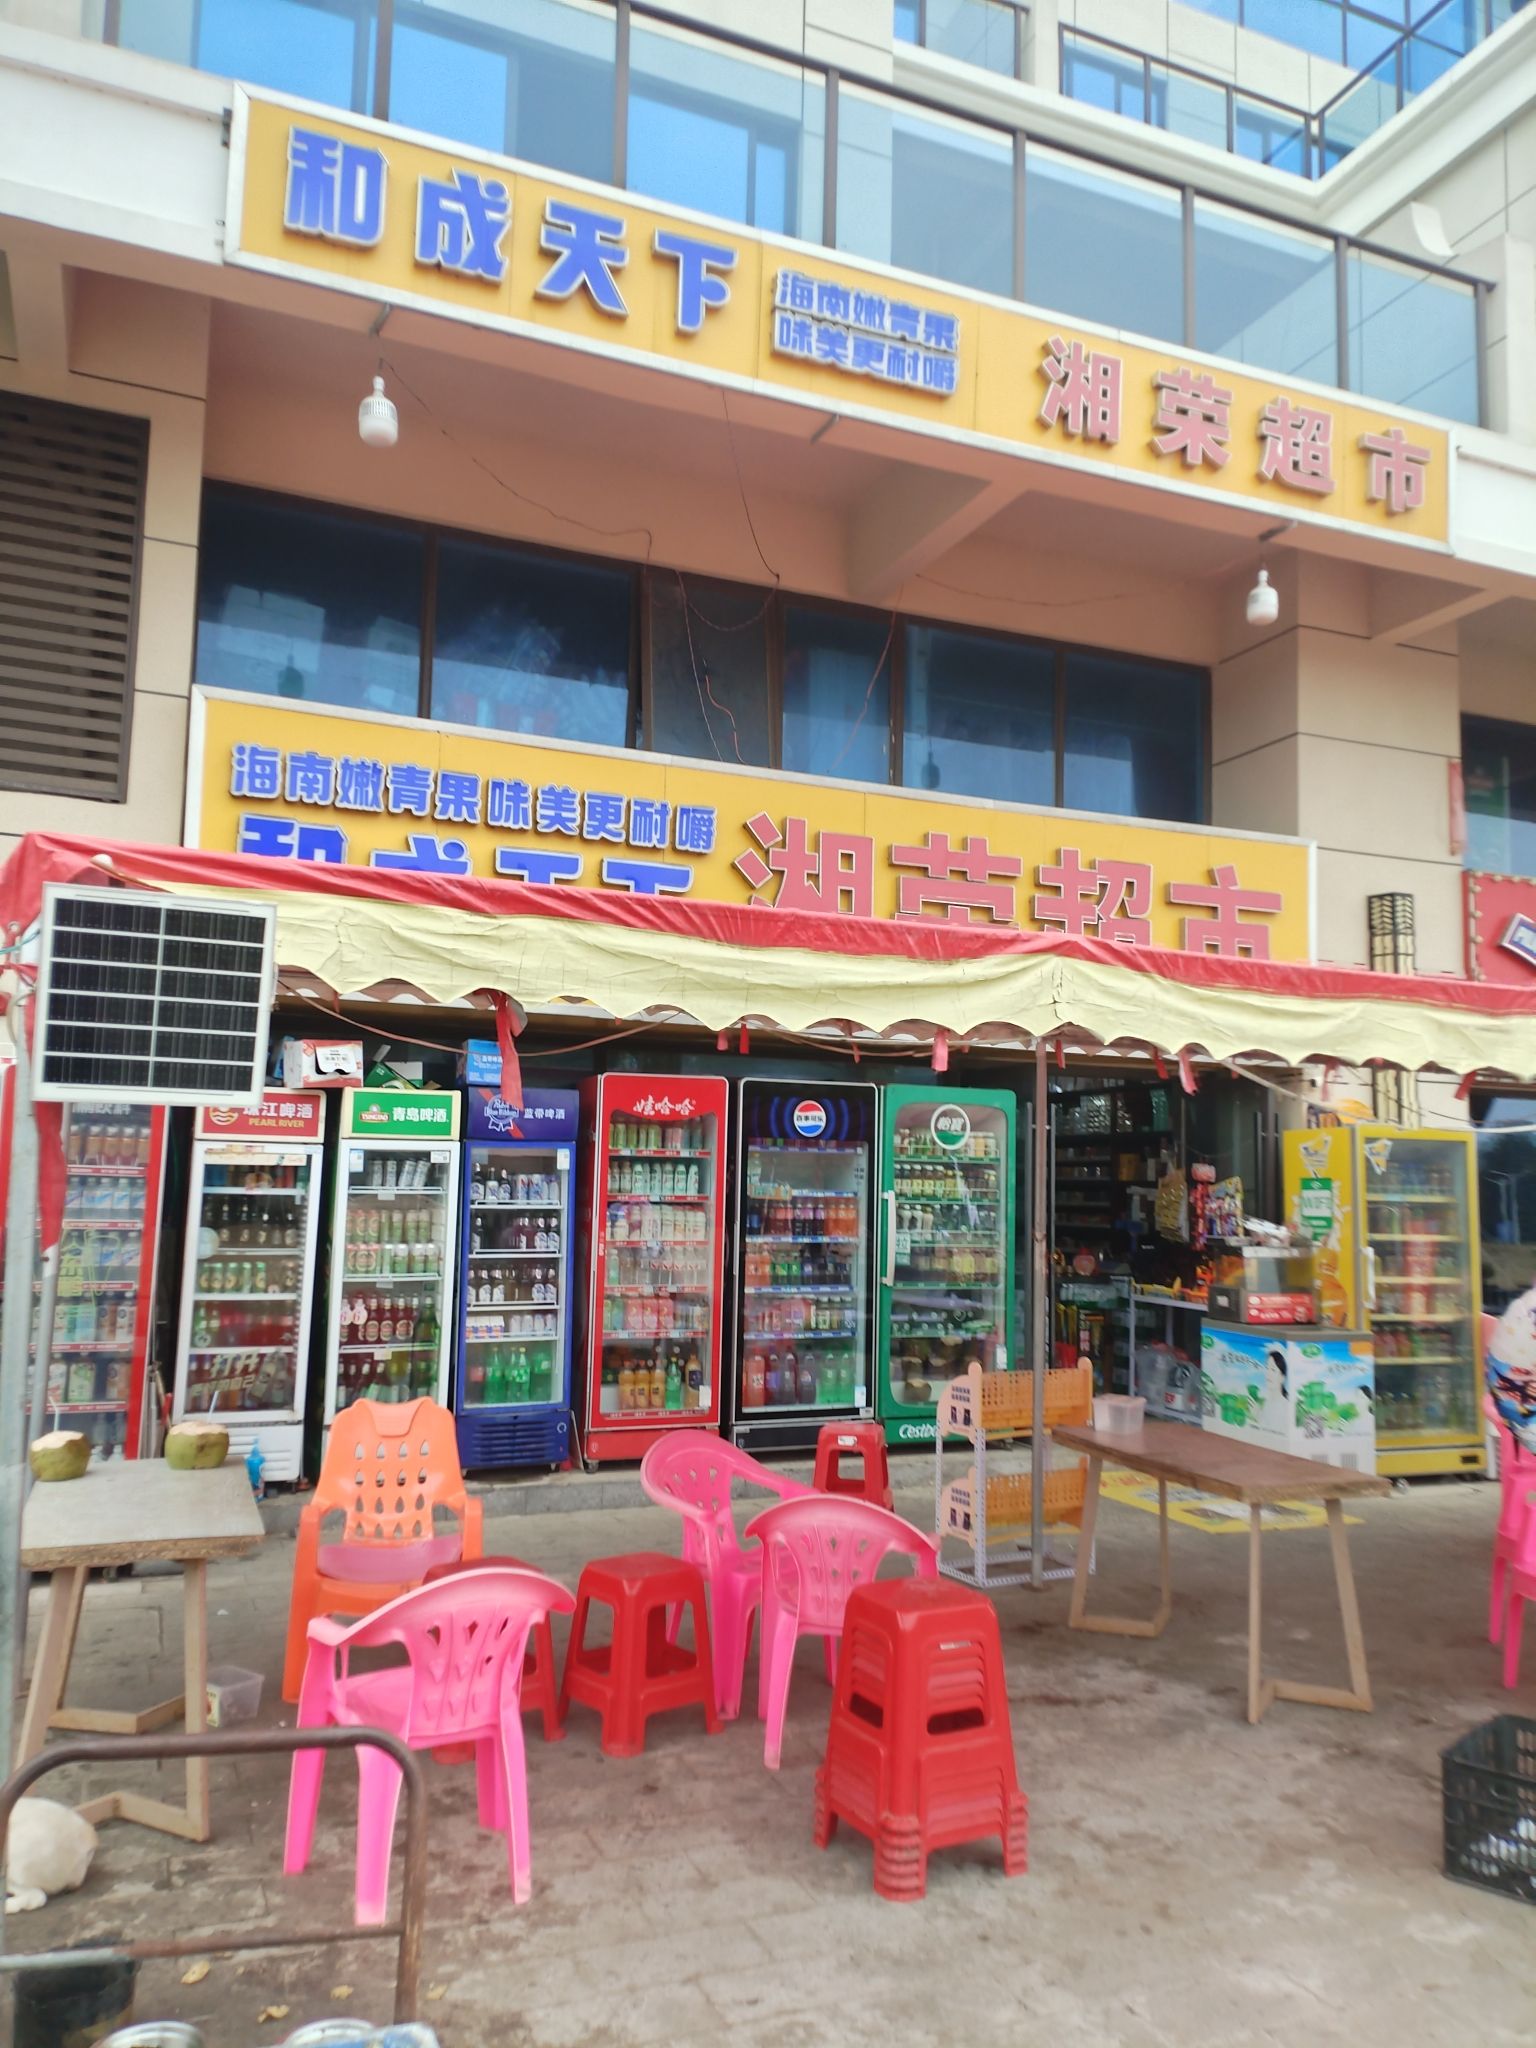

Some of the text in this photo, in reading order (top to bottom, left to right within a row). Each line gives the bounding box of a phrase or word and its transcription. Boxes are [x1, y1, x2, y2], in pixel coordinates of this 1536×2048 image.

[284, 124, 738, 334] 和成天下
[774, 309, 960, 396] 味美更耐嚼
[776, 268, 960, 352] 海南嫩青果
[1038, 334, 1431, 513] 湘荣超市
[229, 742, 719, 855] 海南嫩青果味美更耐嚼
[248, 1118, 305, 1128] PEARL RIVER
[633, 1094, 695, 1116] 娃哈哈
